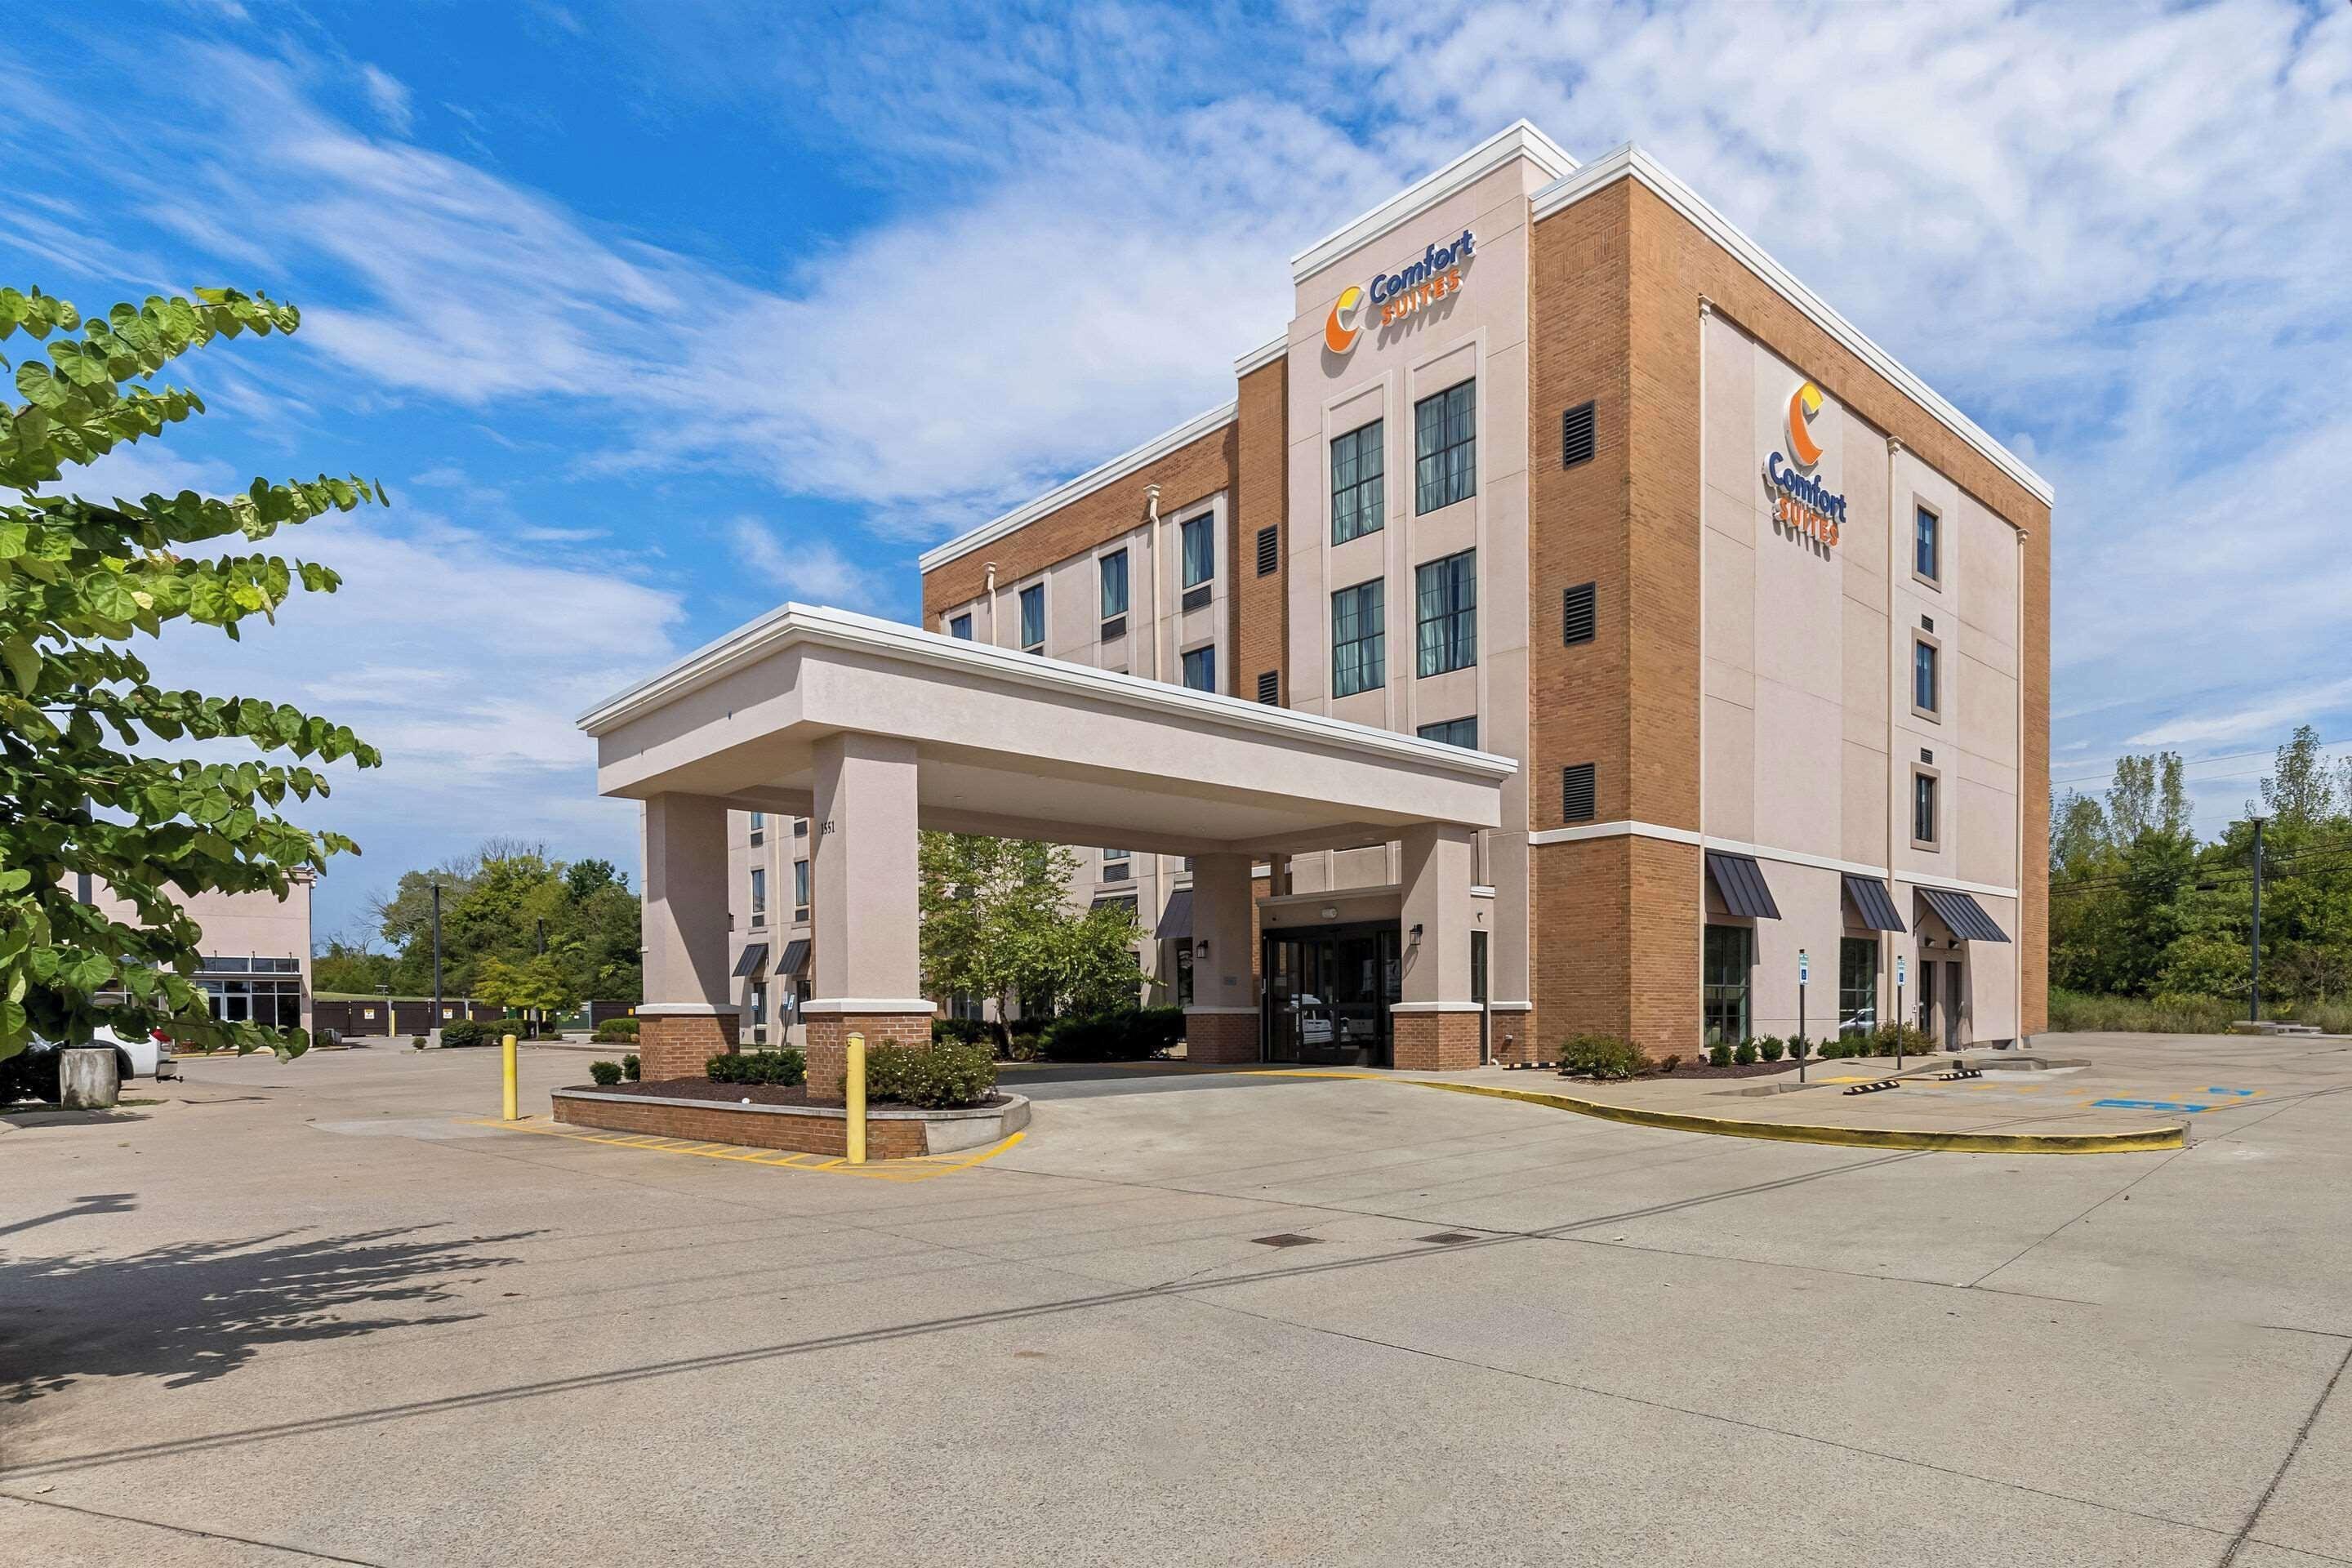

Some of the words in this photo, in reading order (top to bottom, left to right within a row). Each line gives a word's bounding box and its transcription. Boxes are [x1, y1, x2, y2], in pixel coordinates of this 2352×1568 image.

[1370, 229, 1476, 304] Comfort
[1380, 268, 1463, 327] SUITES
[1767, 451, 1846, 523] Comfort
[1776, 496, 1840, 549] SUITES
[821, 820, 835, 835] 1551
